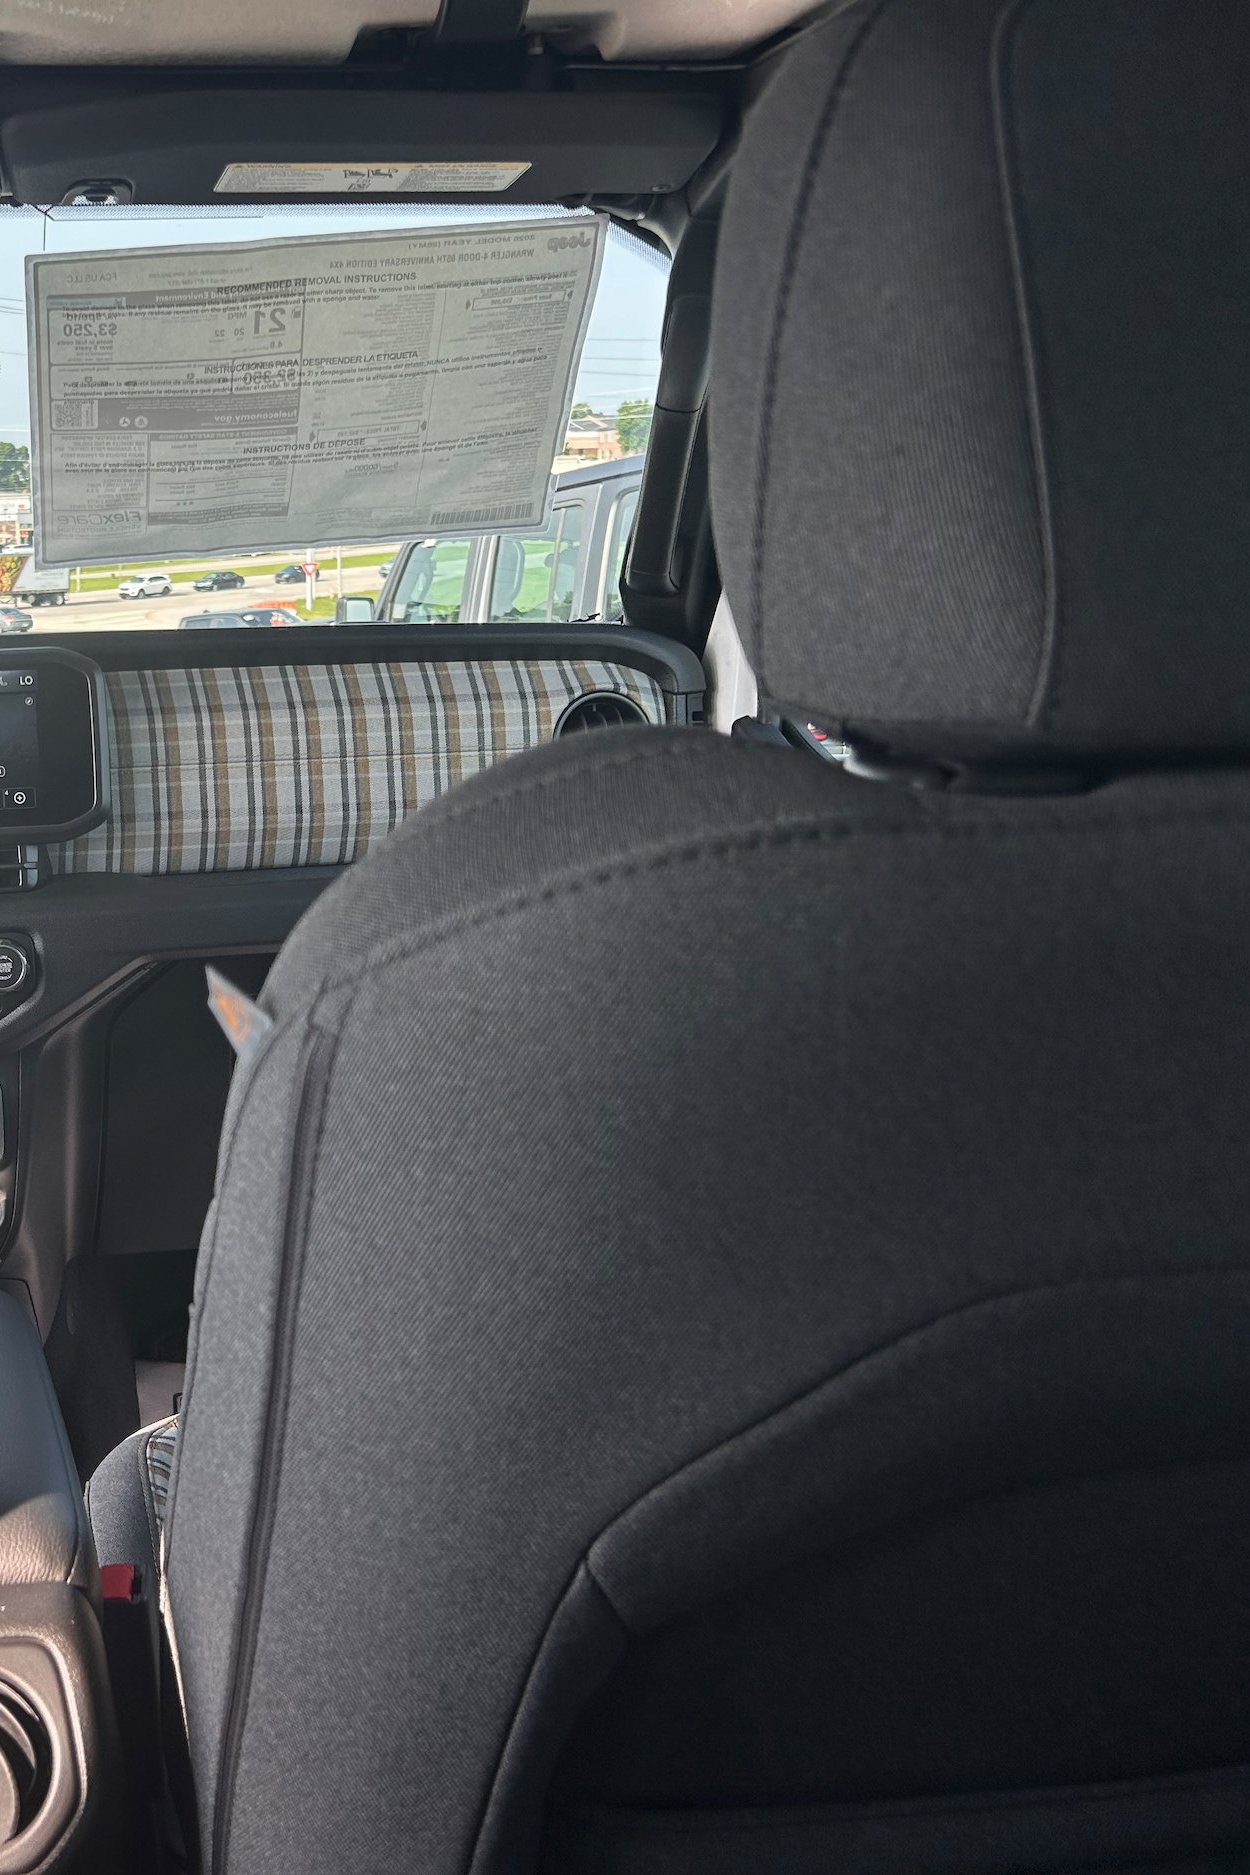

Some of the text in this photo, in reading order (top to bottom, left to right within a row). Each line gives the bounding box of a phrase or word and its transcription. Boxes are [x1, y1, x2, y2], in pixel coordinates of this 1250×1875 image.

[216, 272, 417, 295] RECOMMENDED REMOVAL INSTRUCTIONS
[276, 359, 300, 369] PARA
[302, 356, 362, 366] DESPRENDER
[376, 350, 418, 362] ETIQUETA
[427, 358, 450, 366] NUNCA
[243, 444, 310, 454] INSTRUCTIONS
[20, 676, 34, 686] LO
